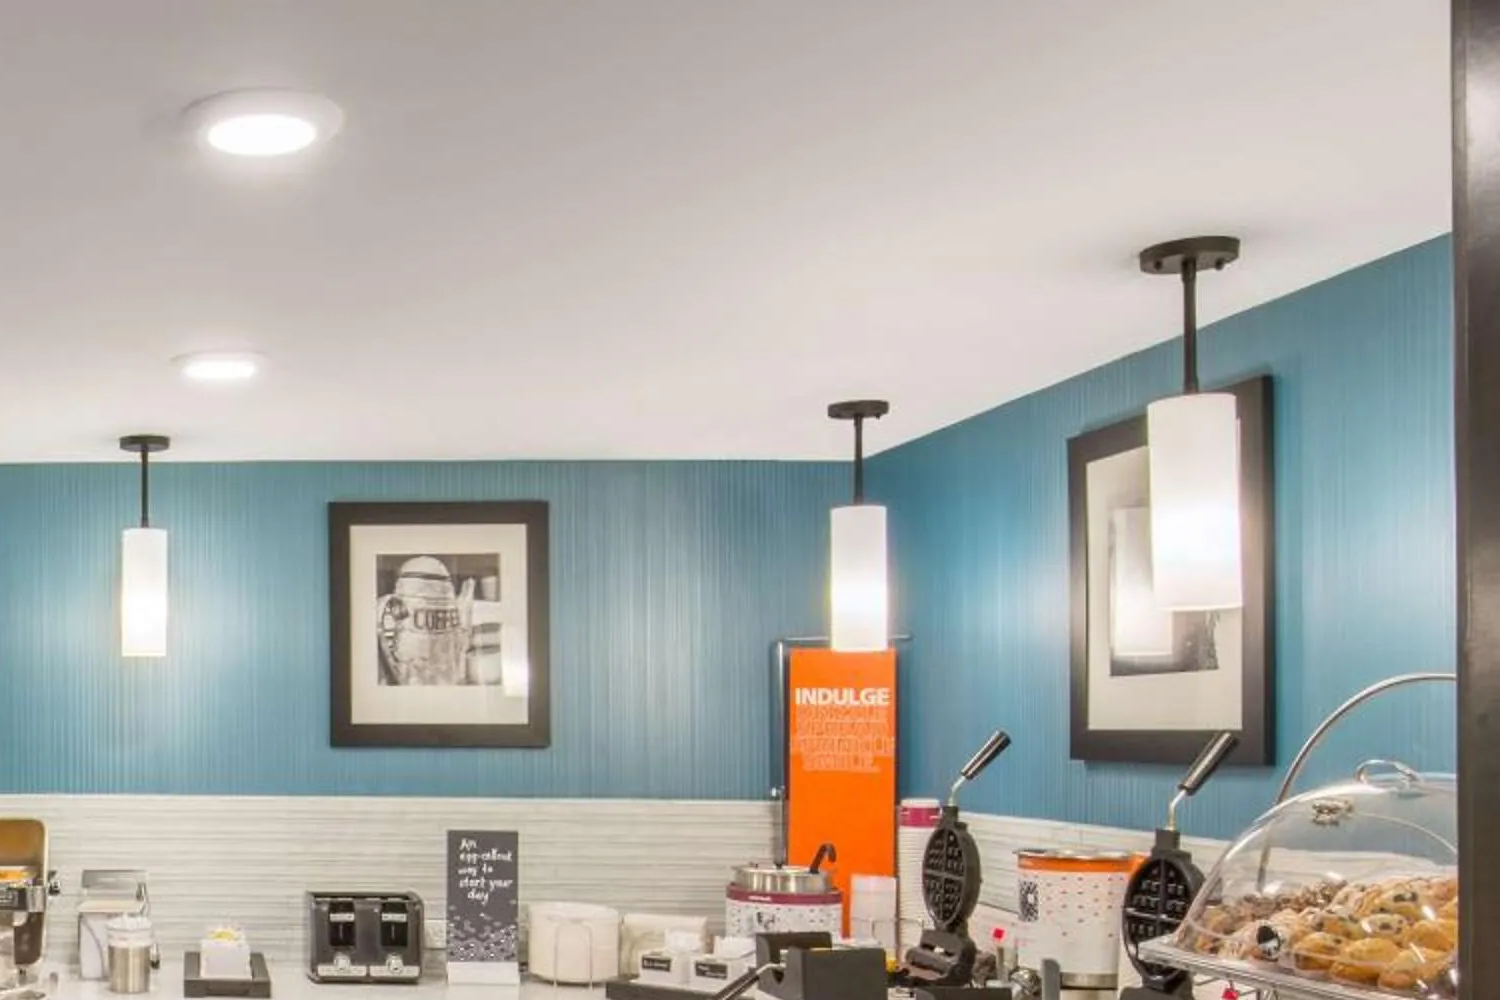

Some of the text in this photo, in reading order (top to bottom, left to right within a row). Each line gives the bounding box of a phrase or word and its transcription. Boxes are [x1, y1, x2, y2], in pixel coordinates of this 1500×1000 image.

[795, 687, 891, 706] INDULGE
[459, 838, 477, 851] An
[482, 862, 494, 874] to
[459, 876, 514, 892] start your
[467, 888, 489, 906] day
